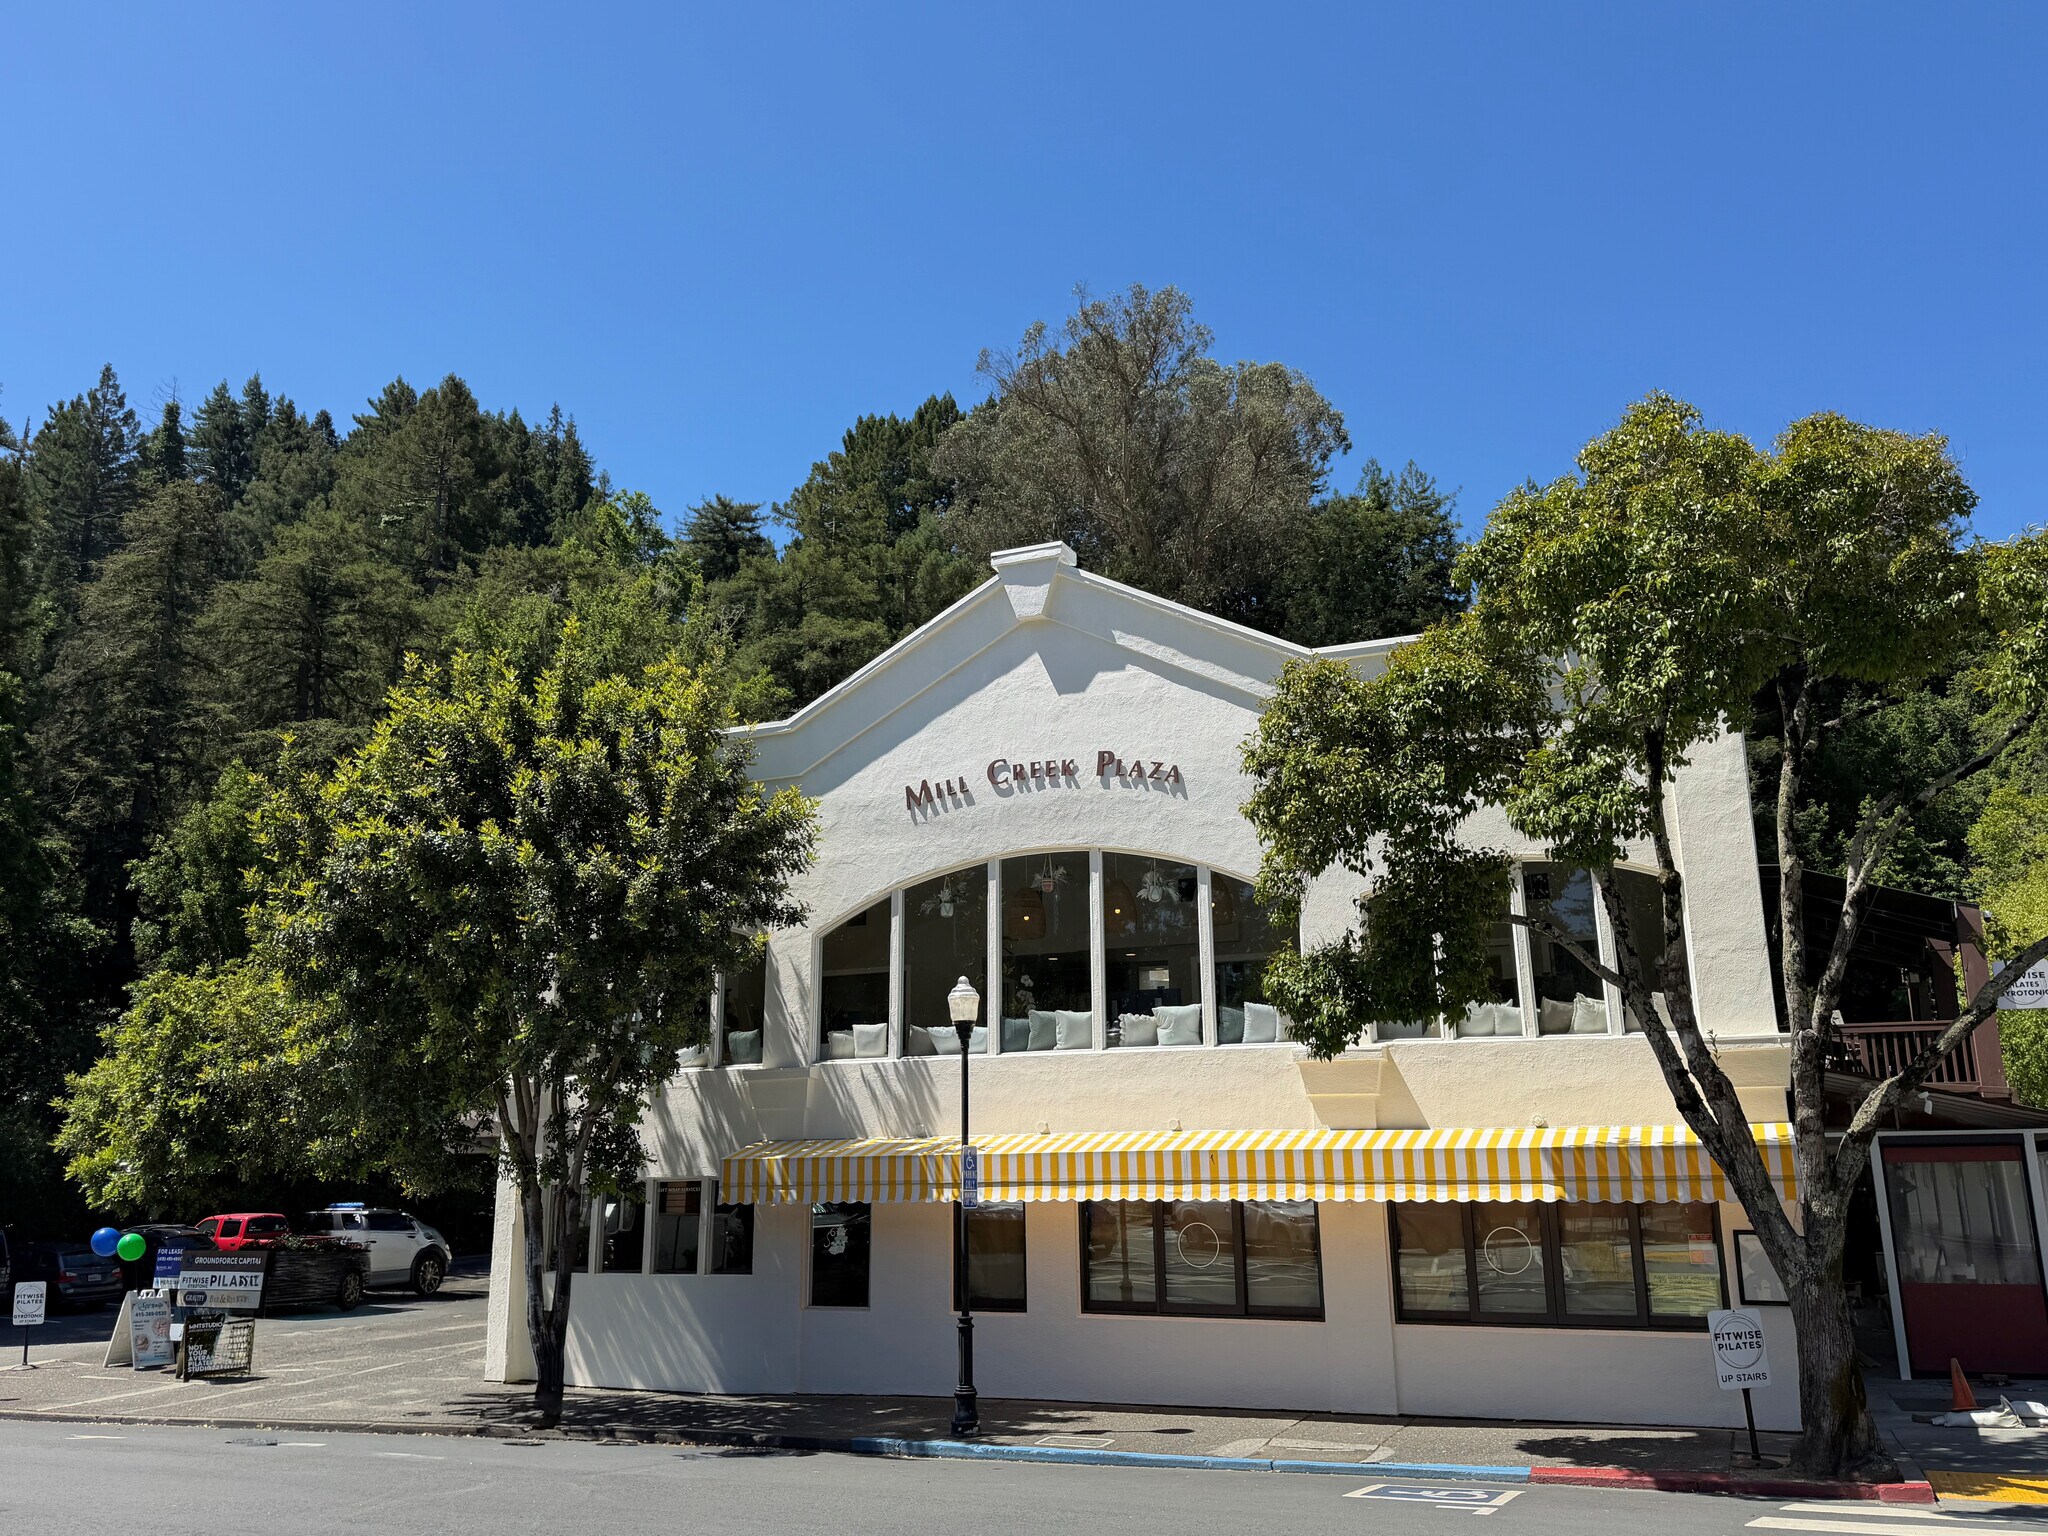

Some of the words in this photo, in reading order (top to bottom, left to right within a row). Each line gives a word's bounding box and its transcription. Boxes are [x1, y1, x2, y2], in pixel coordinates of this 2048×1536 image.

[986, 758, 1076, 786] CREEK
[1096, 750, 1180, 784] PLAZA
[2011, 980, 2040, 988] ILATES
[2004, 989, 2048, 997] YROTONIC
[194, 1256, 238, 1265] GROUNDFORCE
[182, 1276, 209, 1284] FITWISE
[1714, 1330, 1762, 1342] FITWISE
[1717, 1341, 1762, 1351] PILATES
[1721, 1374, 1734, 1383] UP
[1736, 1372, 1768, 1382] STAIRS
